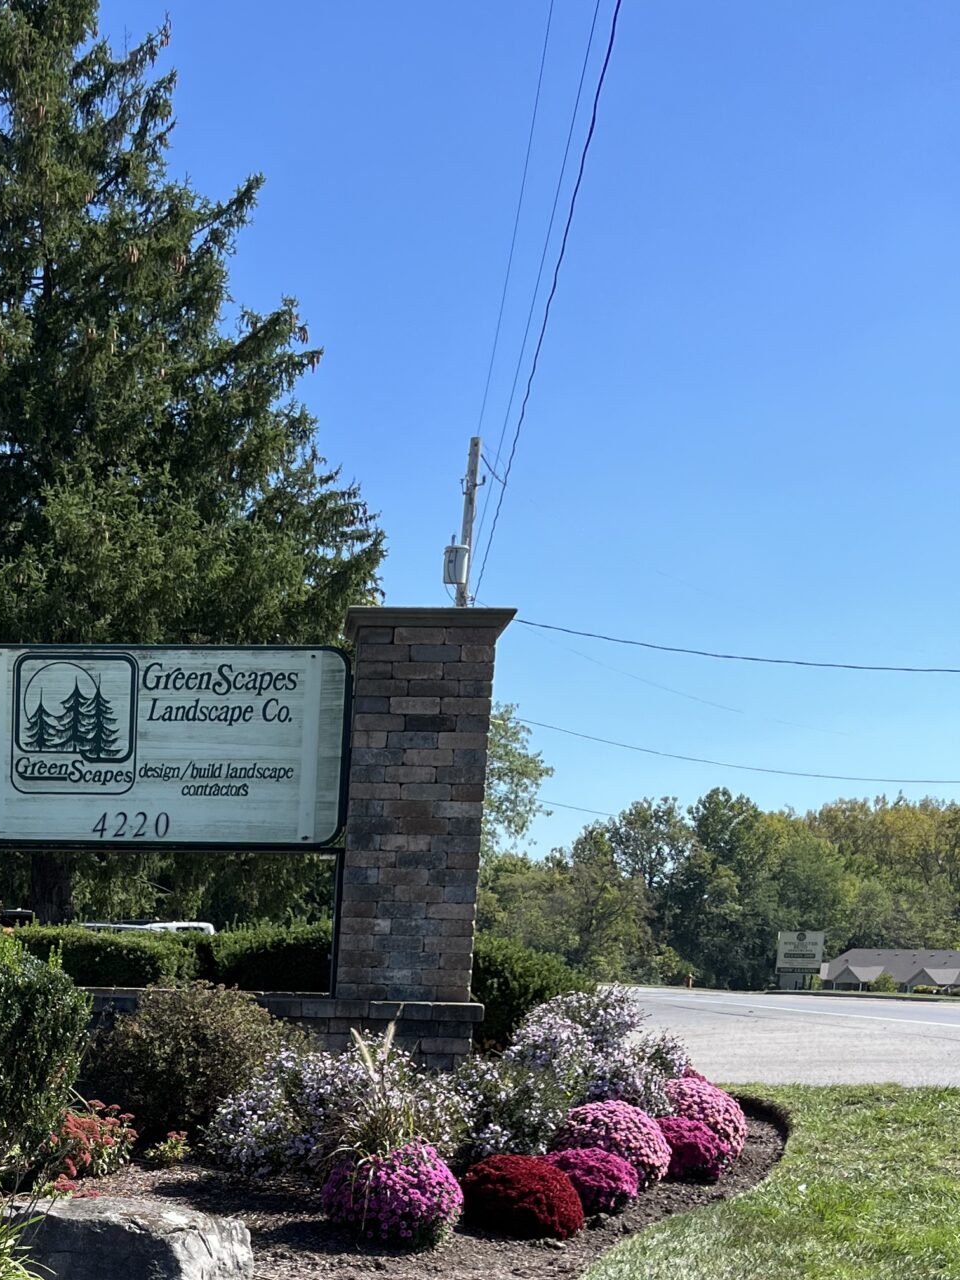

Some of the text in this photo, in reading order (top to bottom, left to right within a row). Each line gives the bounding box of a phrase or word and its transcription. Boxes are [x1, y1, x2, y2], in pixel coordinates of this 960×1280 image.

[142, 662, 299, 696] GreenScapes
[146, 698, 293, 726] Landscape Co.
[15, 757, 133, 785] GreenScapes
[138, 761, 294, 782] design/build landscape
[181, 783, 249, 797] contractors
[92, 812, 170, 838] 4220
